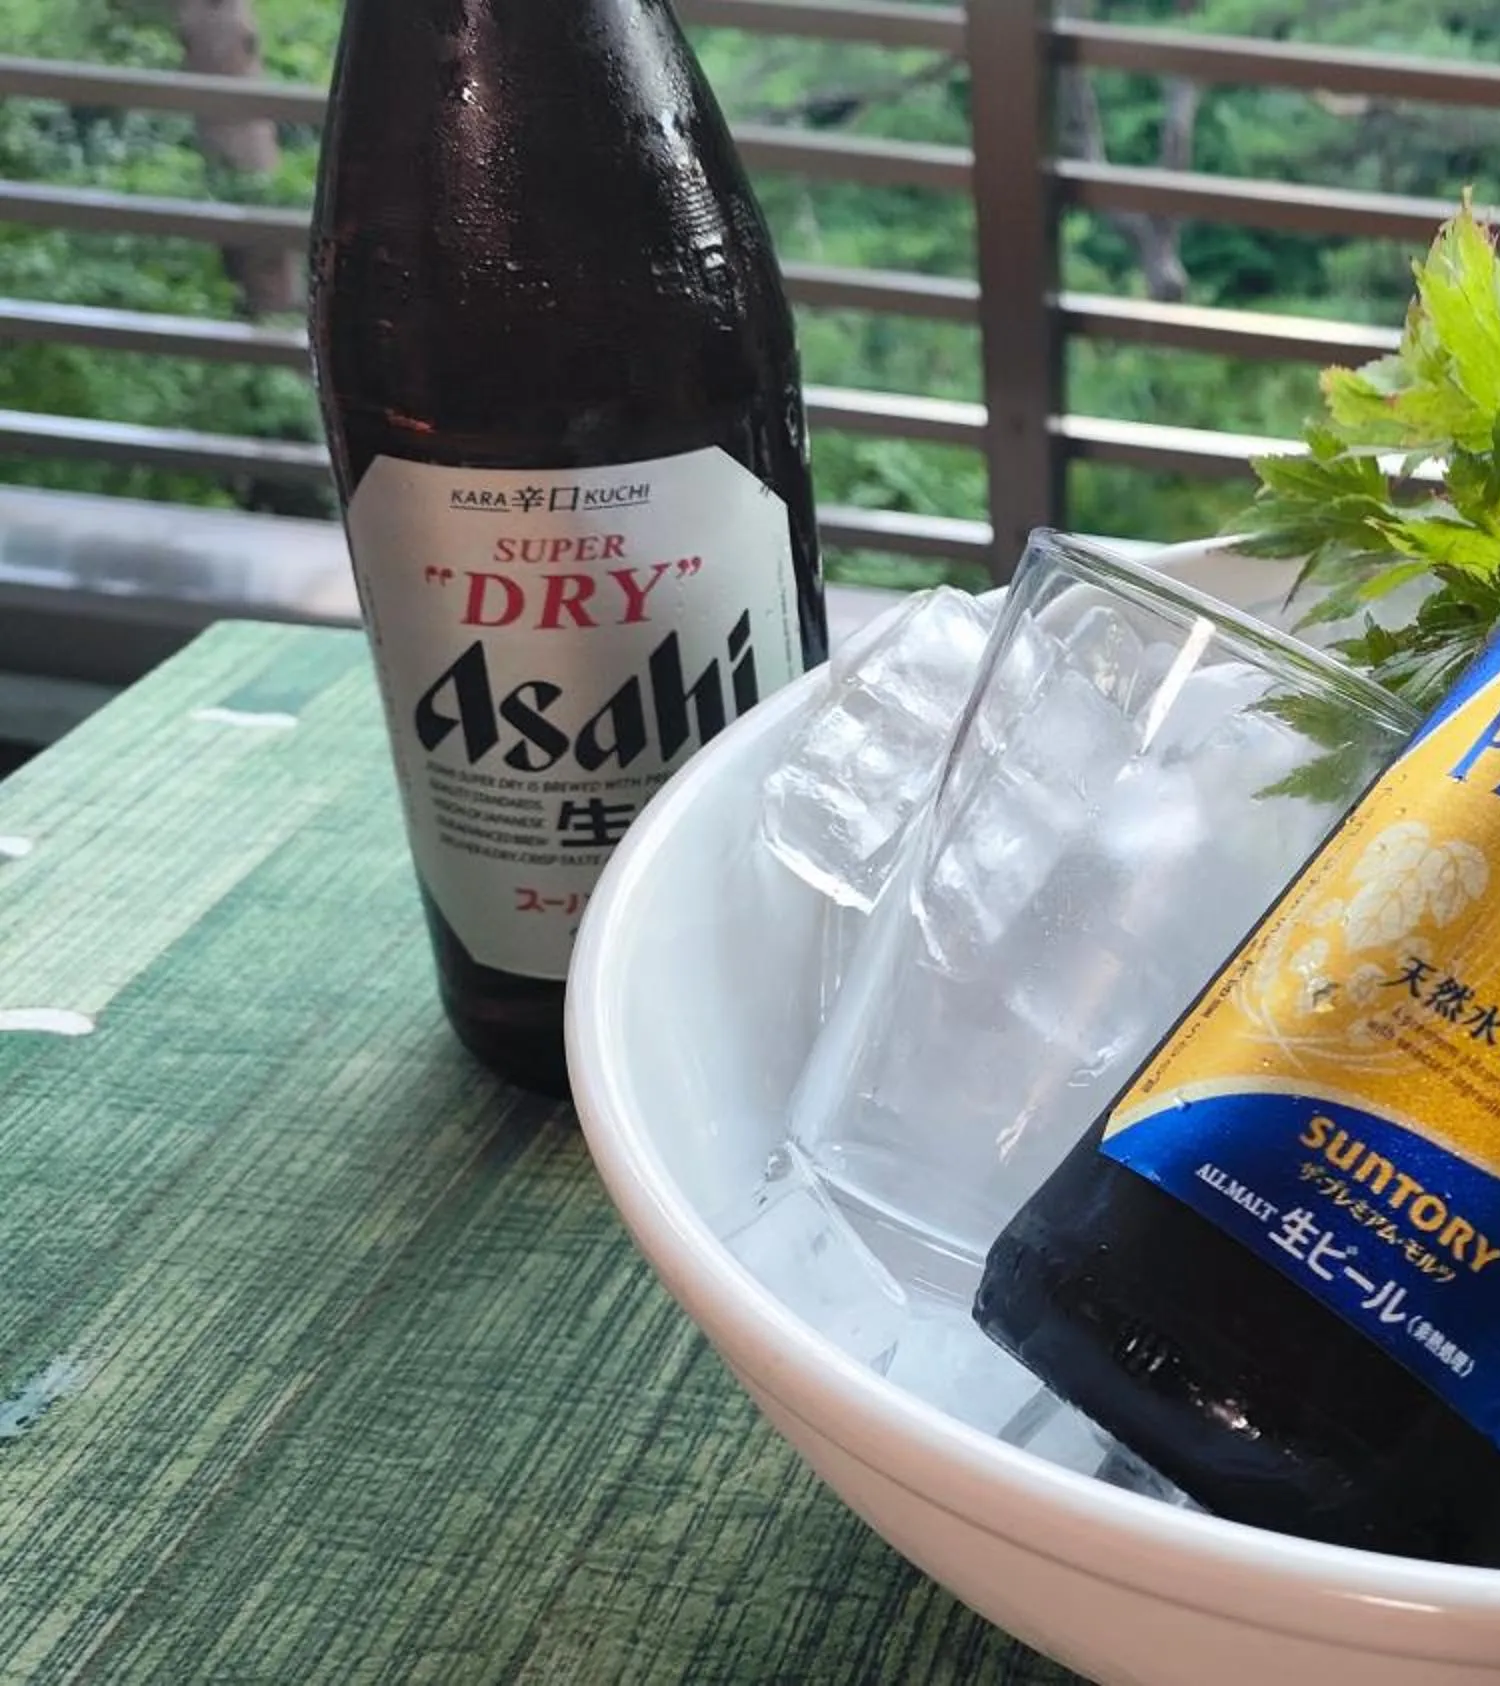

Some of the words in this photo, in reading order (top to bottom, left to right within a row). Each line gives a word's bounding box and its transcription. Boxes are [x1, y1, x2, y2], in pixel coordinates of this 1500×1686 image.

[450, 489, 508, 507] KARA
[511, 485, 580, 513] 辛口
[584, 483, 651, 506] KUCHI
[493, 534, 626, 564] SUPER
[414, 607, 760, 773] Asahi
[557, 797, 635, 848] 生
[1267, 1207, 1407, 1324] 生ビール
